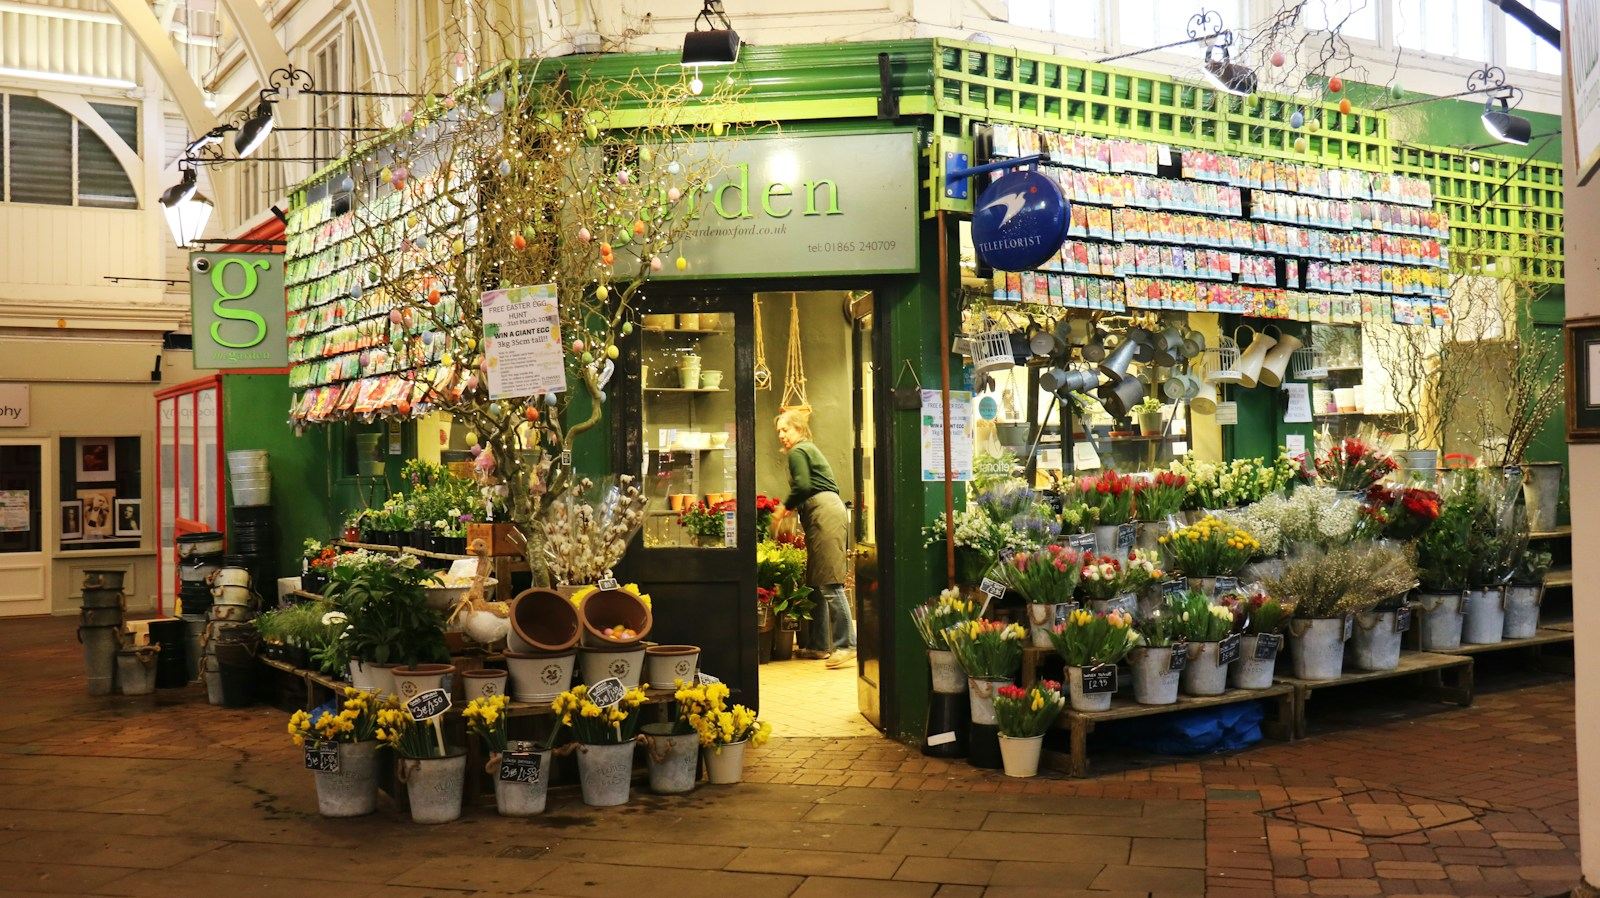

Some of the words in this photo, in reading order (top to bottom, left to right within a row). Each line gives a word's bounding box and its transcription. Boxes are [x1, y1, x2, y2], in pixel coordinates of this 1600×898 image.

[824, 242, 856, 253] 01865
[858, 240, 897, 252] 240709
[978, 235, 1042, 253] TELEFLORIST
[488, 305, 506, 314] FREE
[506, 301, 531, 312] EASTER
[532, 299, 547, 308] EGG
[508, 311, 528, 319] HUNT
[519, 317, 538, 325] March
[494, 331, 509, 340] WIN
[515, 327, 536, 337] GIANT
[536, 326, 550, 335] EGG
[497, 340, 511, 349] 3kg
[511, 337, 531, 347] 35cm
[501, 765, 510, 779] 3
